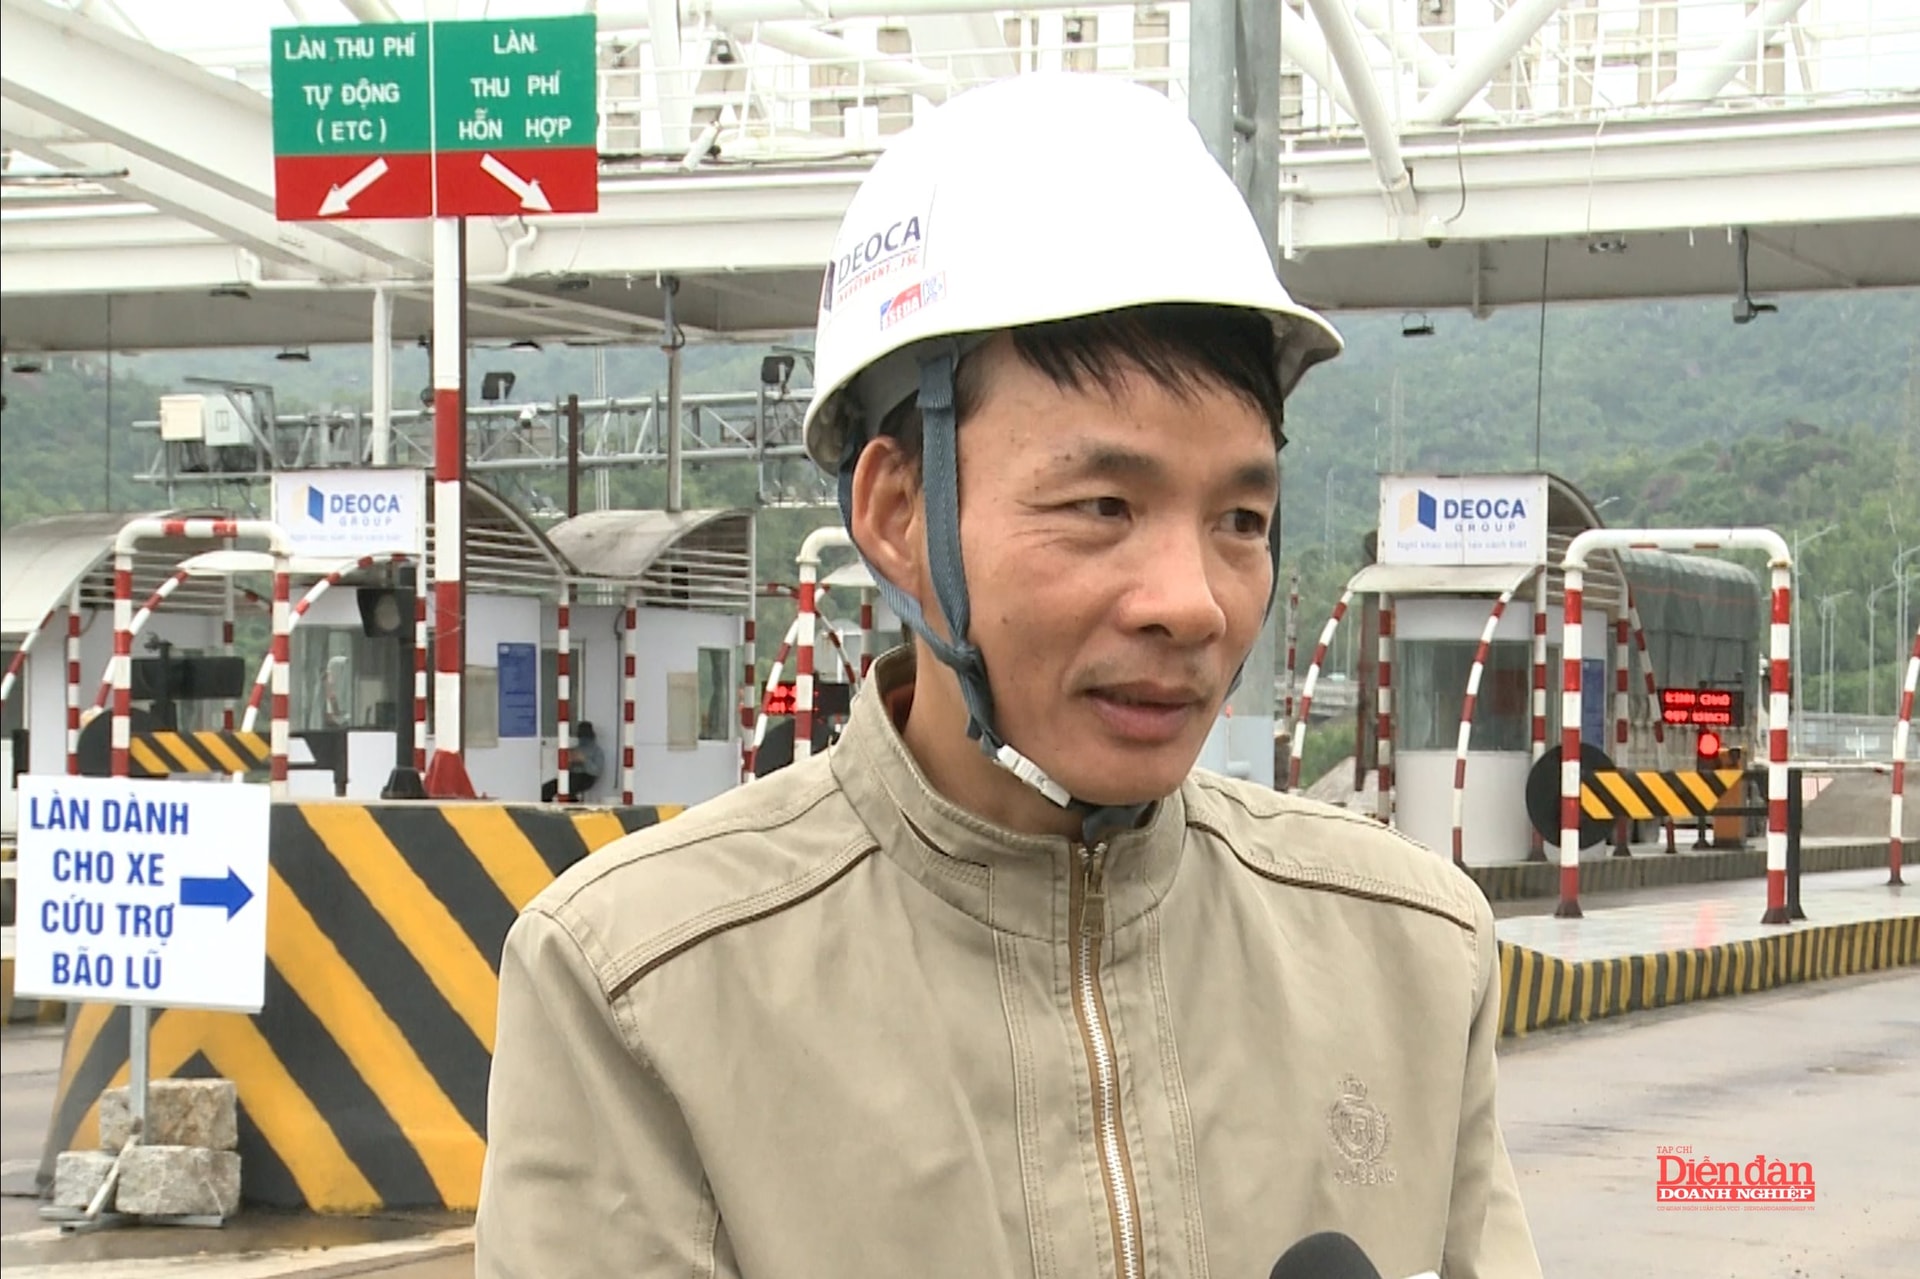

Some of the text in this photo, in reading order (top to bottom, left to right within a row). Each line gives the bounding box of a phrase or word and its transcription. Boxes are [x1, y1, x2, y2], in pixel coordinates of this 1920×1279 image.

[285, 33, 416, 60] LÀN THU PHÍ
[493, 29, 536, 55] LÀN
[303, 77, 400, 110] TỰ ĐỘNG
[470, 70, 561, 98] THU PHÍ
[459, 107, 572, 143] HỖN HỢP
[838, 216, 921, 285] DEOCA
[330, 494, 401, 514] DEOCA
[1444, 499, 1527, 519] DEOCA
[339, 516, 392, 527] GROUP
[1455, 522, 1516, 532] GROUP
[30, 789, 189, 835] LÀN DÀNH
[53, 849, 165, 886] CHO XE
[41, 894, 175, 946] CỨU TRỢ
[52, 946, 162, 990] BÃO LŨ
